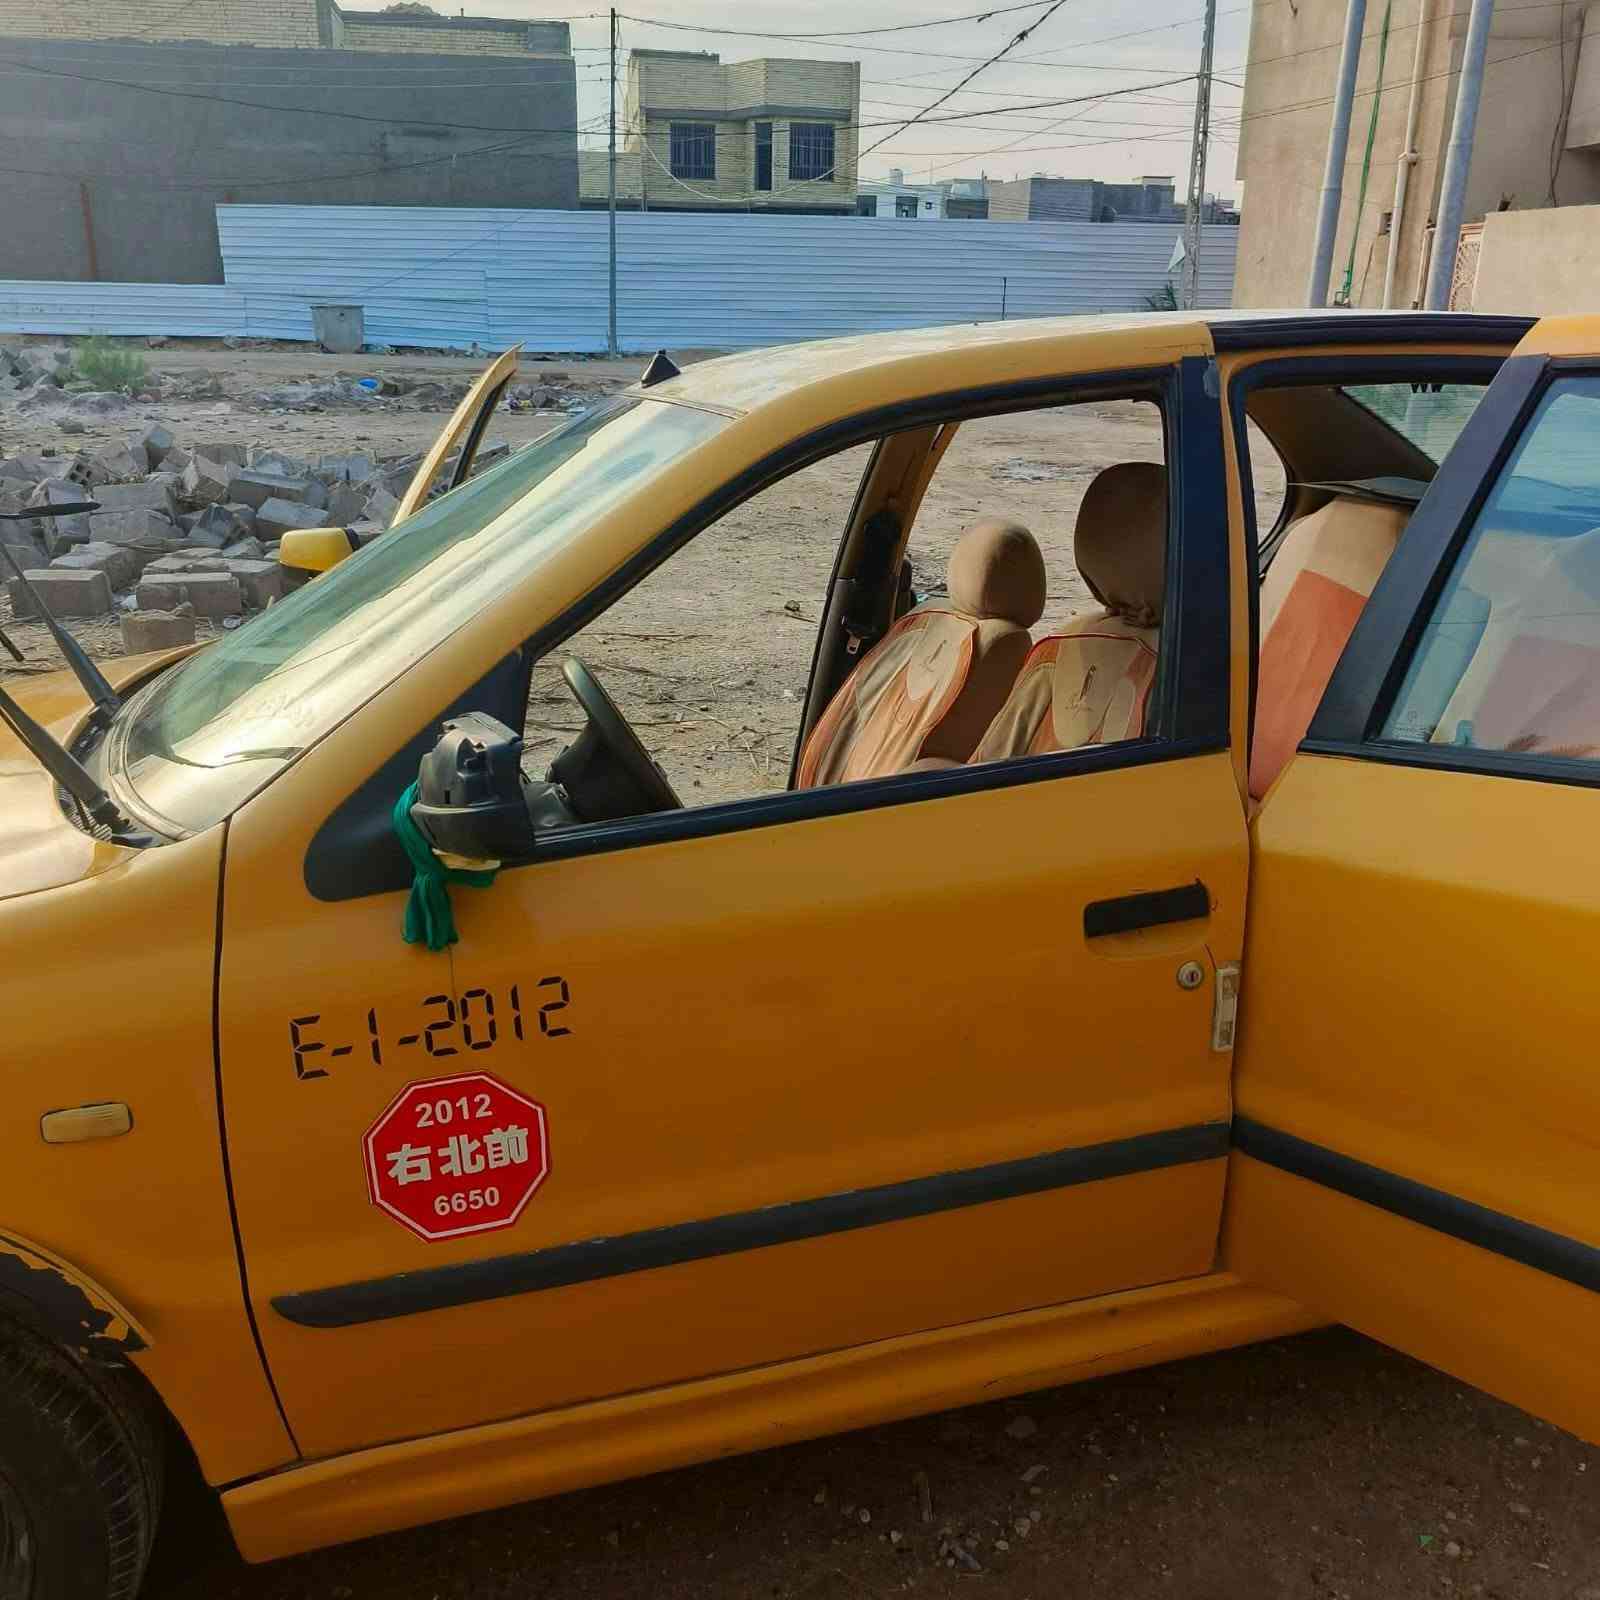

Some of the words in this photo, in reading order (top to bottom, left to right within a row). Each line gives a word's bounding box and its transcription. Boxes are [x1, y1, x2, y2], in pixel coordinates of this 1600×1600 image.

[289, 976, 572, 1080] E-1-2012
[416, 1094, 493, 1128] 2012
[386, 1125, 529, 1185] 右北前
[434, 1186, 500, 1216] 6650
